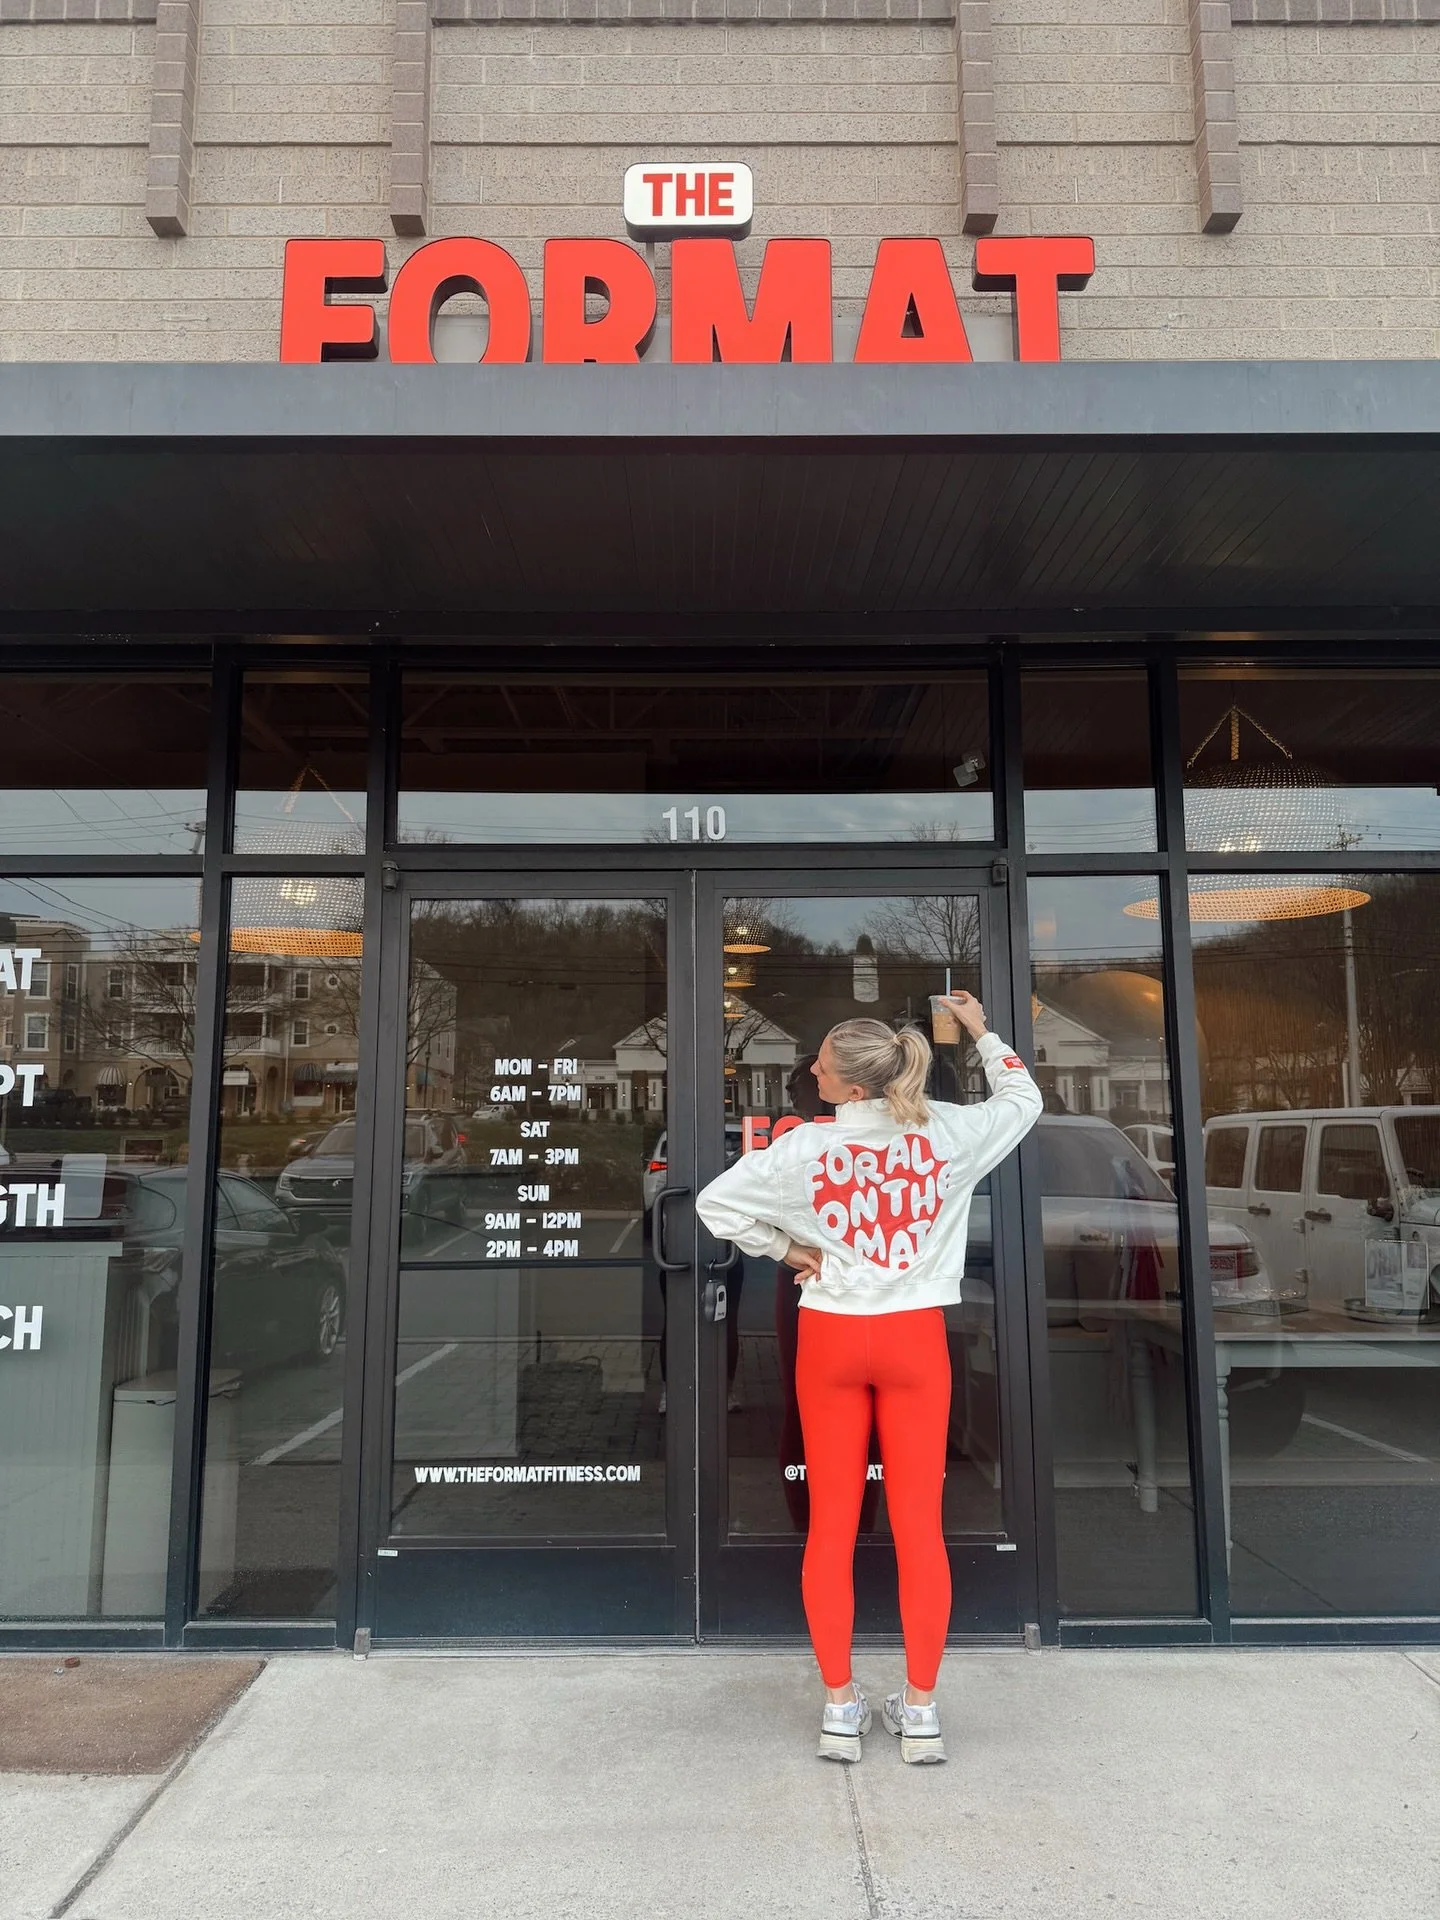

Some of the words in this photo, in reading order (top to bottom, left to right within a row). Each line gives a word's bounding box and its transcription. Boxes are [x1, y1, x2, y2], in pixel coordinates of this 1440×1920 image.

[642, 172, 734, 217] THE
[280, 236, 1095, 363] FORMAT
[662, 805, 726, 841] 110
[494, 1058, 532, 1075] MON
[553, 1058, 578, 1075] FRI
[490, 1085, 526, 1102] 6AM
[547, 1085, 581, 1102] 7PM
[520, 1121, 550, 1138] SAT
[489, 1148, 523, 1165] 7AM
[544, 1148, 579, 1165] 3PM
[805, 1144, 886, 1204] FOR
[517, 1185, 550, 1202] SUN
[484, 1213, 520, 1230] 9AM
[542, 1212, 581, 1229] 12PM
[818, 1186, 879, 1241] ON
[486, 1240, 521, 1258] 2PM
[543, 1239, 579, 1257] 4PM
[854, 1220, 932, 1272] MAT
[414, 1465, 641, 1483] WWW.THEFORMATFITNESS.COM
